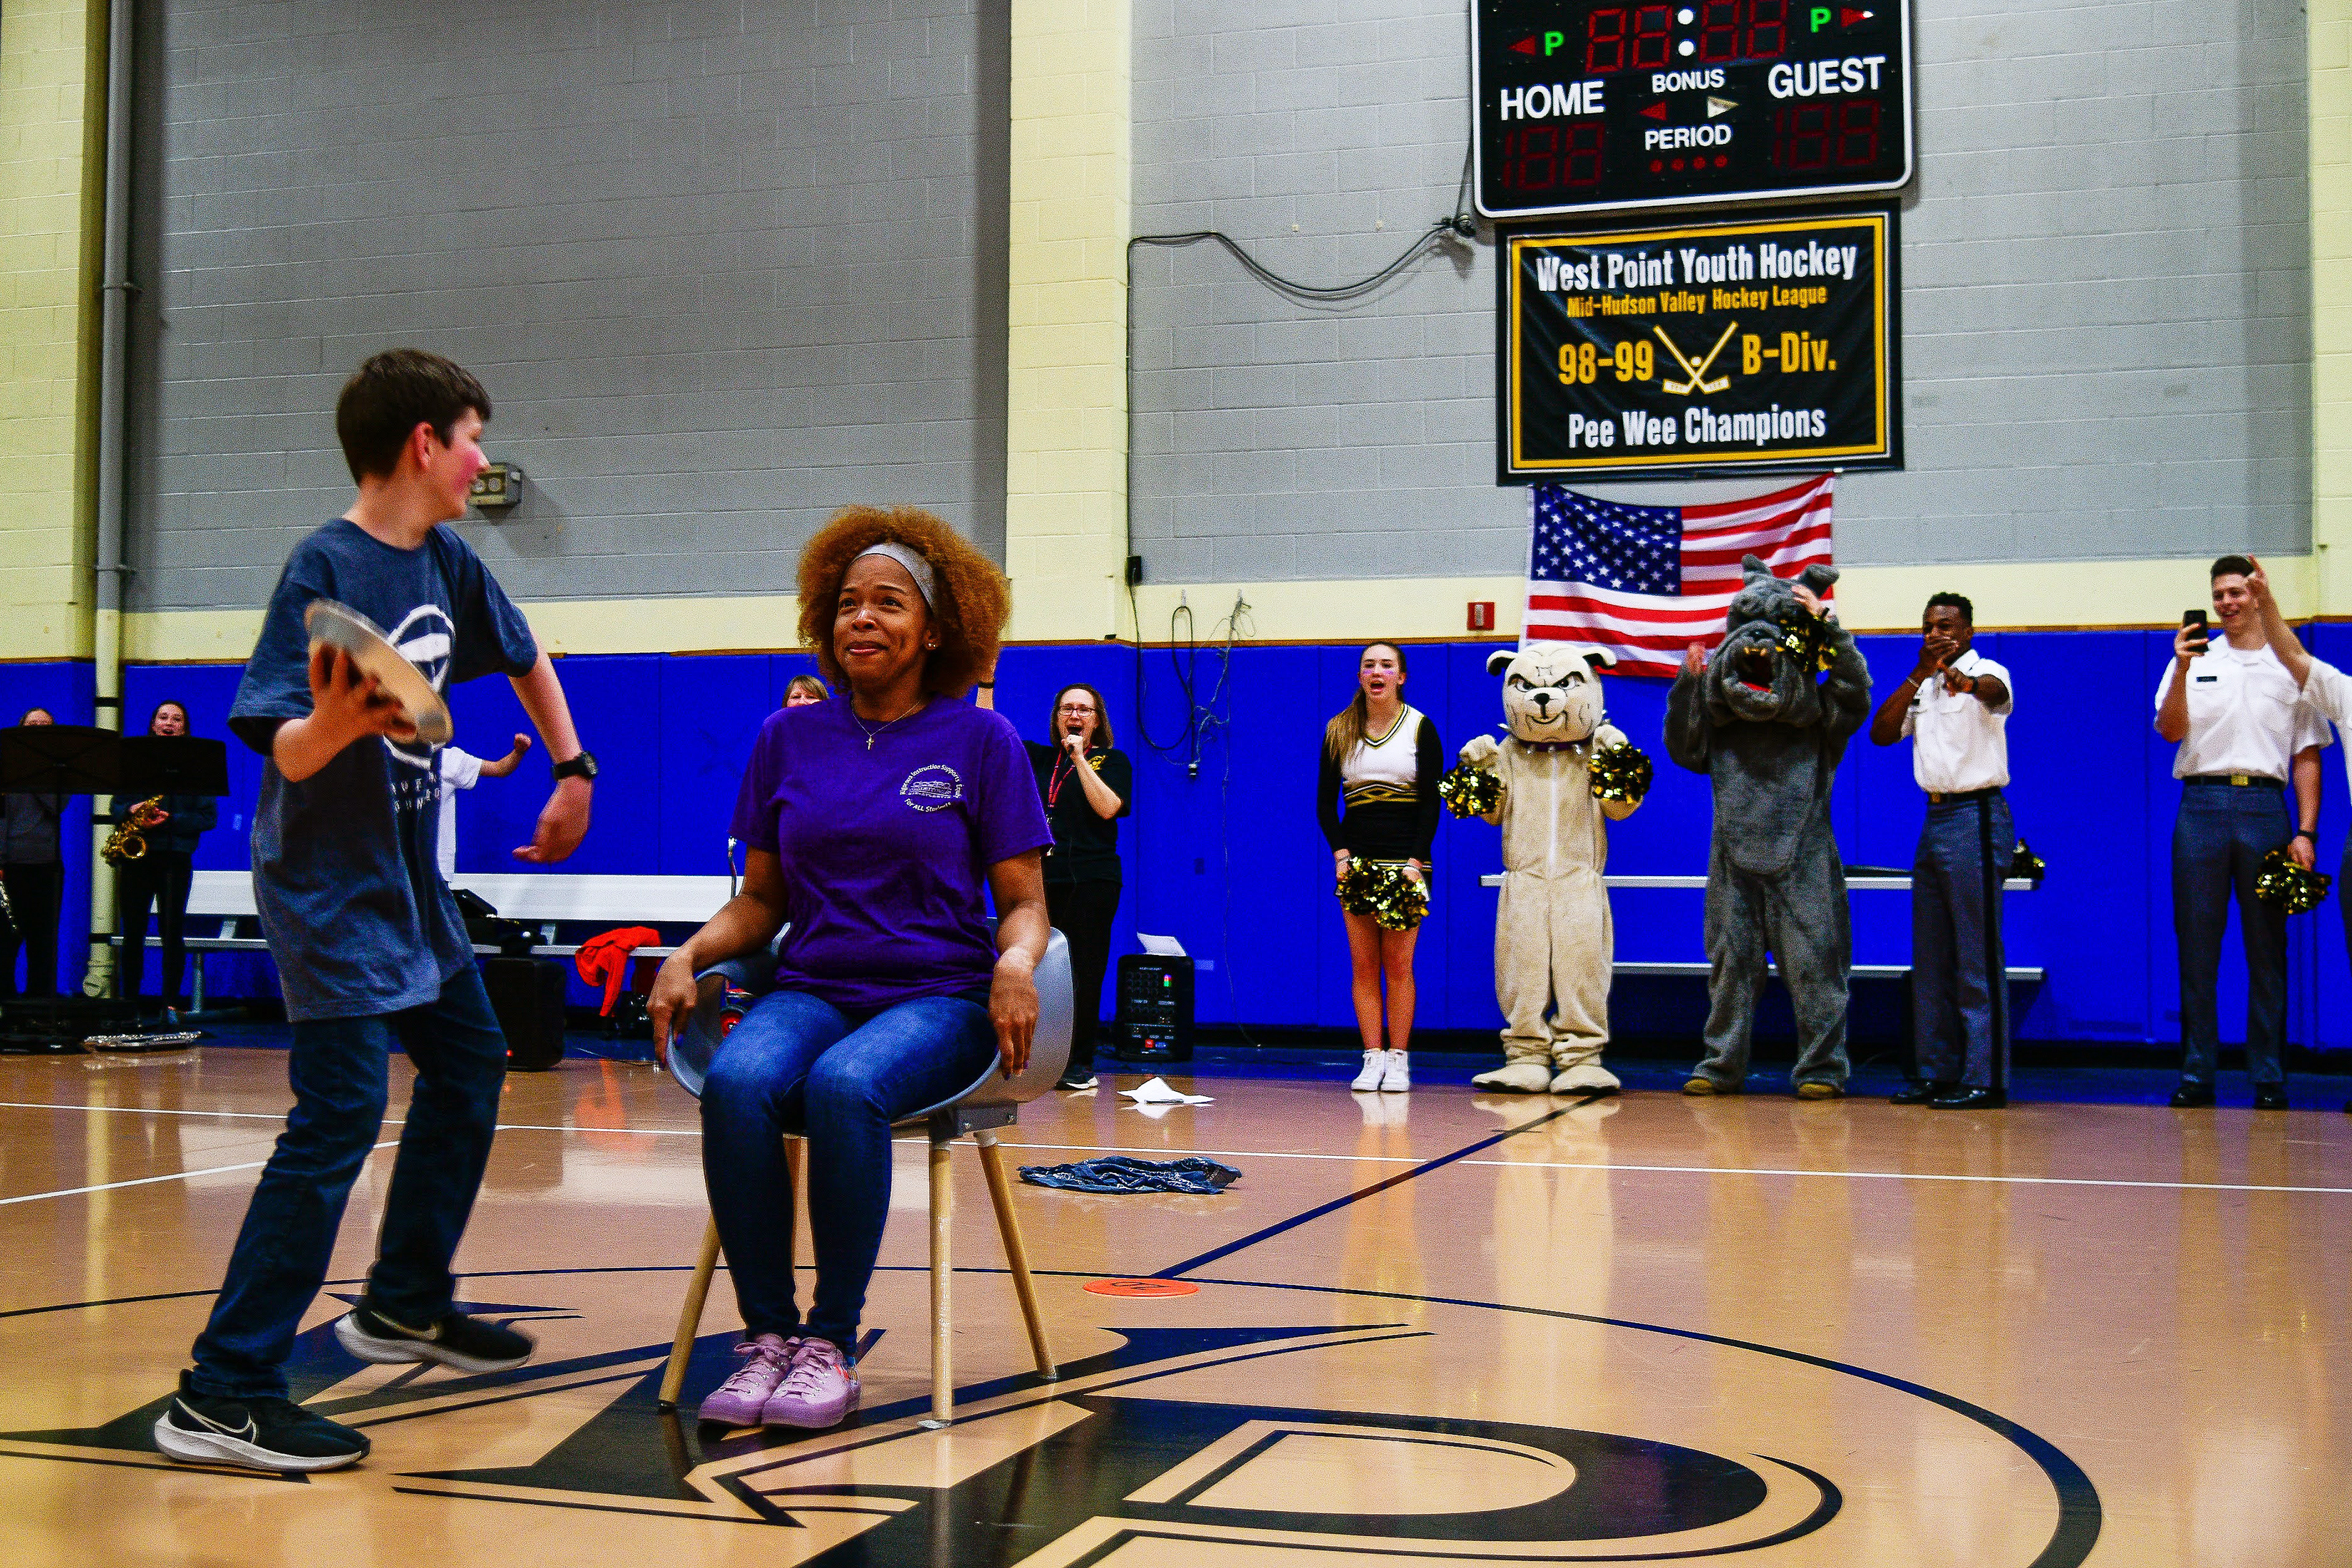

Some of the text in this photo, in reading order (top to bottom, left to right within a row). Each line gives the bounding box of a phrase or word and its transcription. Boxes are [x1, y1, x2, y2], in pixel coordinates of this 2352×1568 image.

[1810, 6, 1832, 33] P
[1544, 31, 1564, 56] P
[1651, 68, 1726, 93] BONUS
[1768, 55, 1886, 98] GUEST
[1500, 80, 1605, 120] HOME
[1645, 124, 1733, 150] PERIOD
[1536, 239, 1857, 292] West Point Youth Hockey
[1567, 284, 1828, 318] Mid-Hudson Valley Hockey League
[1559, 339, 1654, 384] 98-99
[1742, 331, 1837, 375] B-Div.
[1568, 403, 1826, 449] Pee Wee Champions
[910, 764, 941, 777] Instruction
[940, 764, 960, 783] Supports
[904, 798, 914, 807] For
